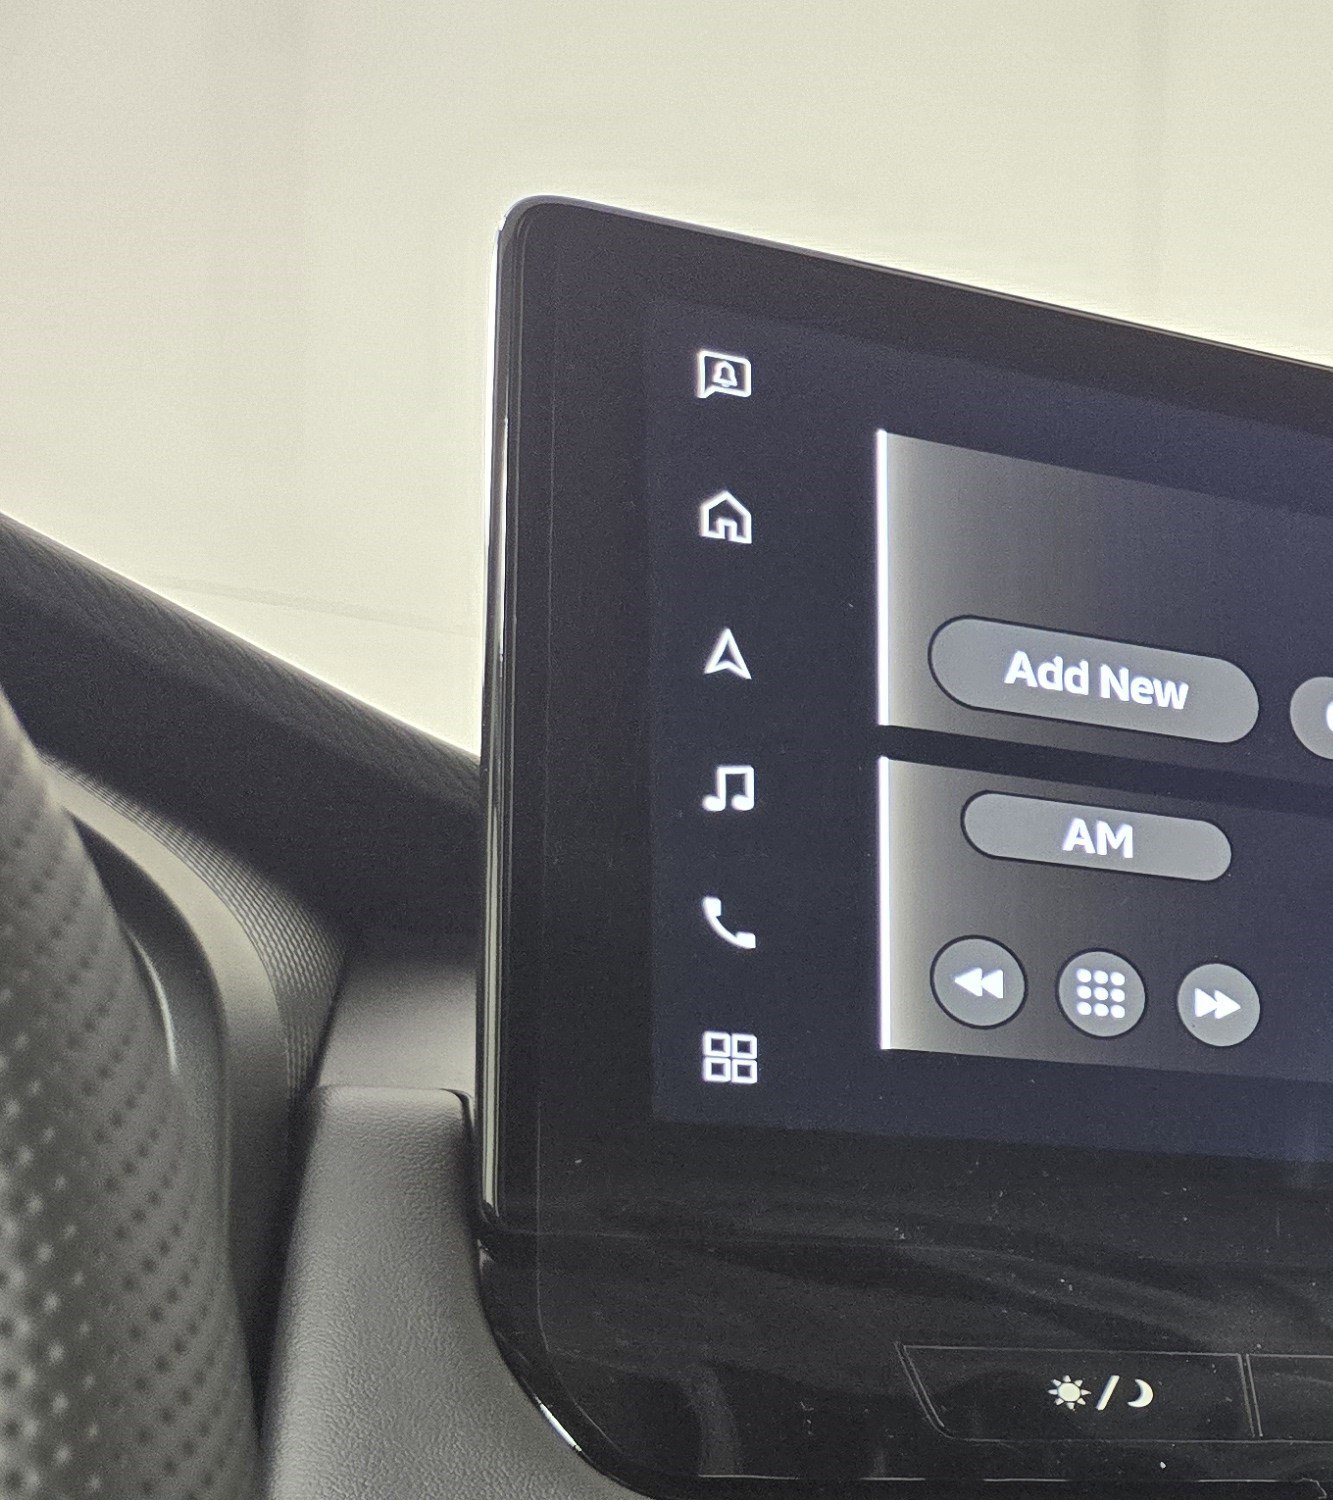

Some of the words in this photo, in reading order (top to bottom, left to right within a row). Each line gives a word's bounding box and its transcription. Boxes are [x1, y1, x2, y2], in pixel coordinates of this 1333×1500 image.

[1004, 650, 1089, 696] Add
[1099, 663, 1189, 710] New
[1062, 817, 1134, 859] AM
